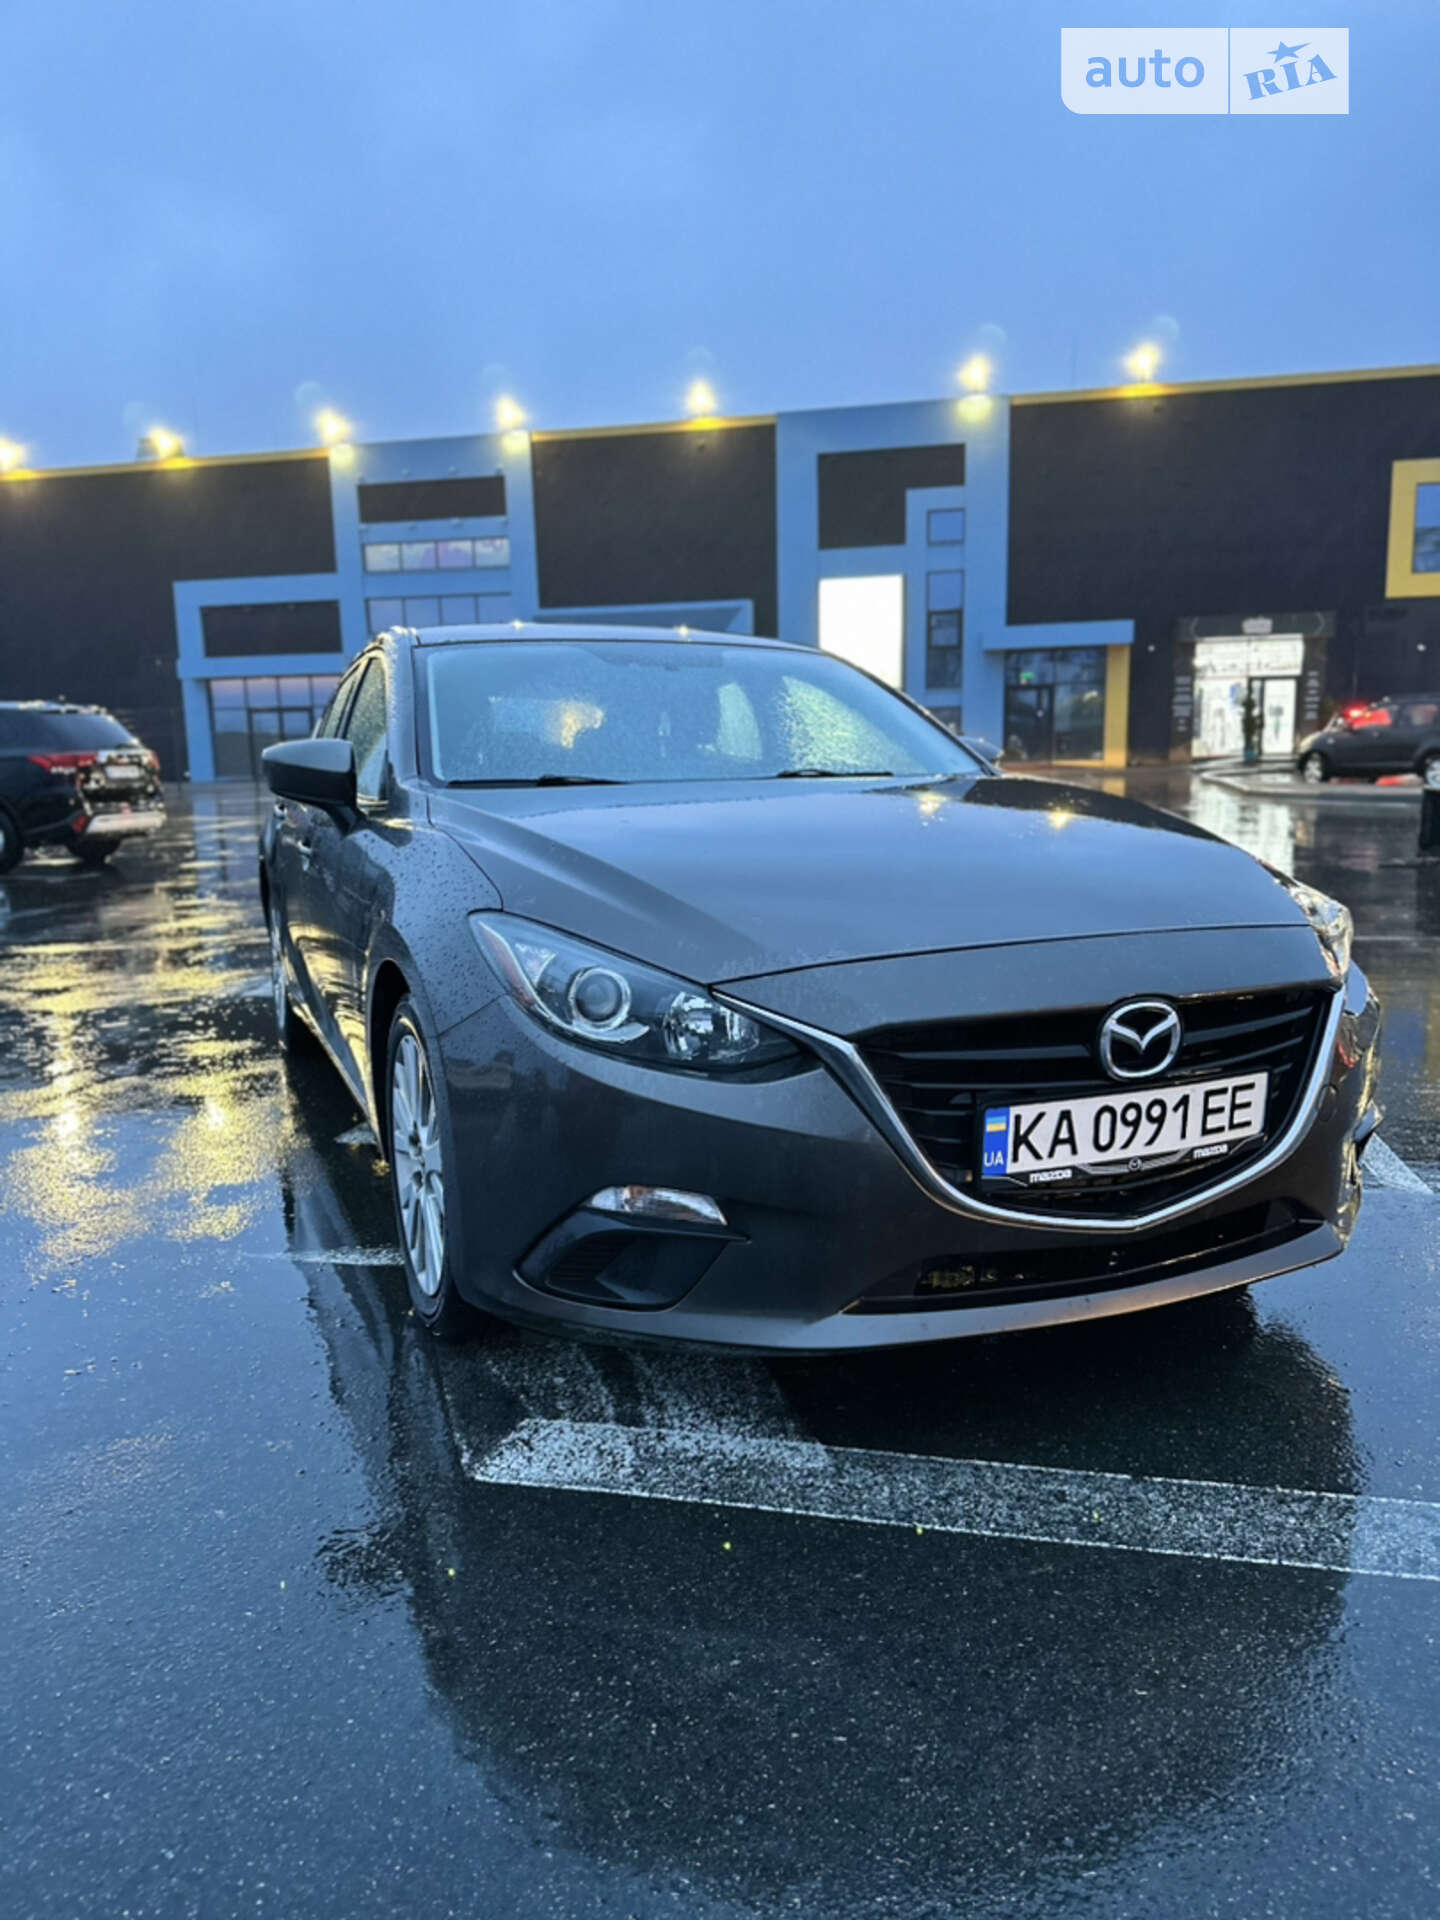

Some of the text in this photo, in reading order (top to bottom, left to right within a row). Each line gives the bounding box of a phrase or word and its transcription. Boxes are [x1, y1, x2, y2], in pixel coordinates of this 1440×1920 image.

[1012, 1082, 1256, 1163] KA 0991 EE
[984, 1151, 1004, 1167] UA
